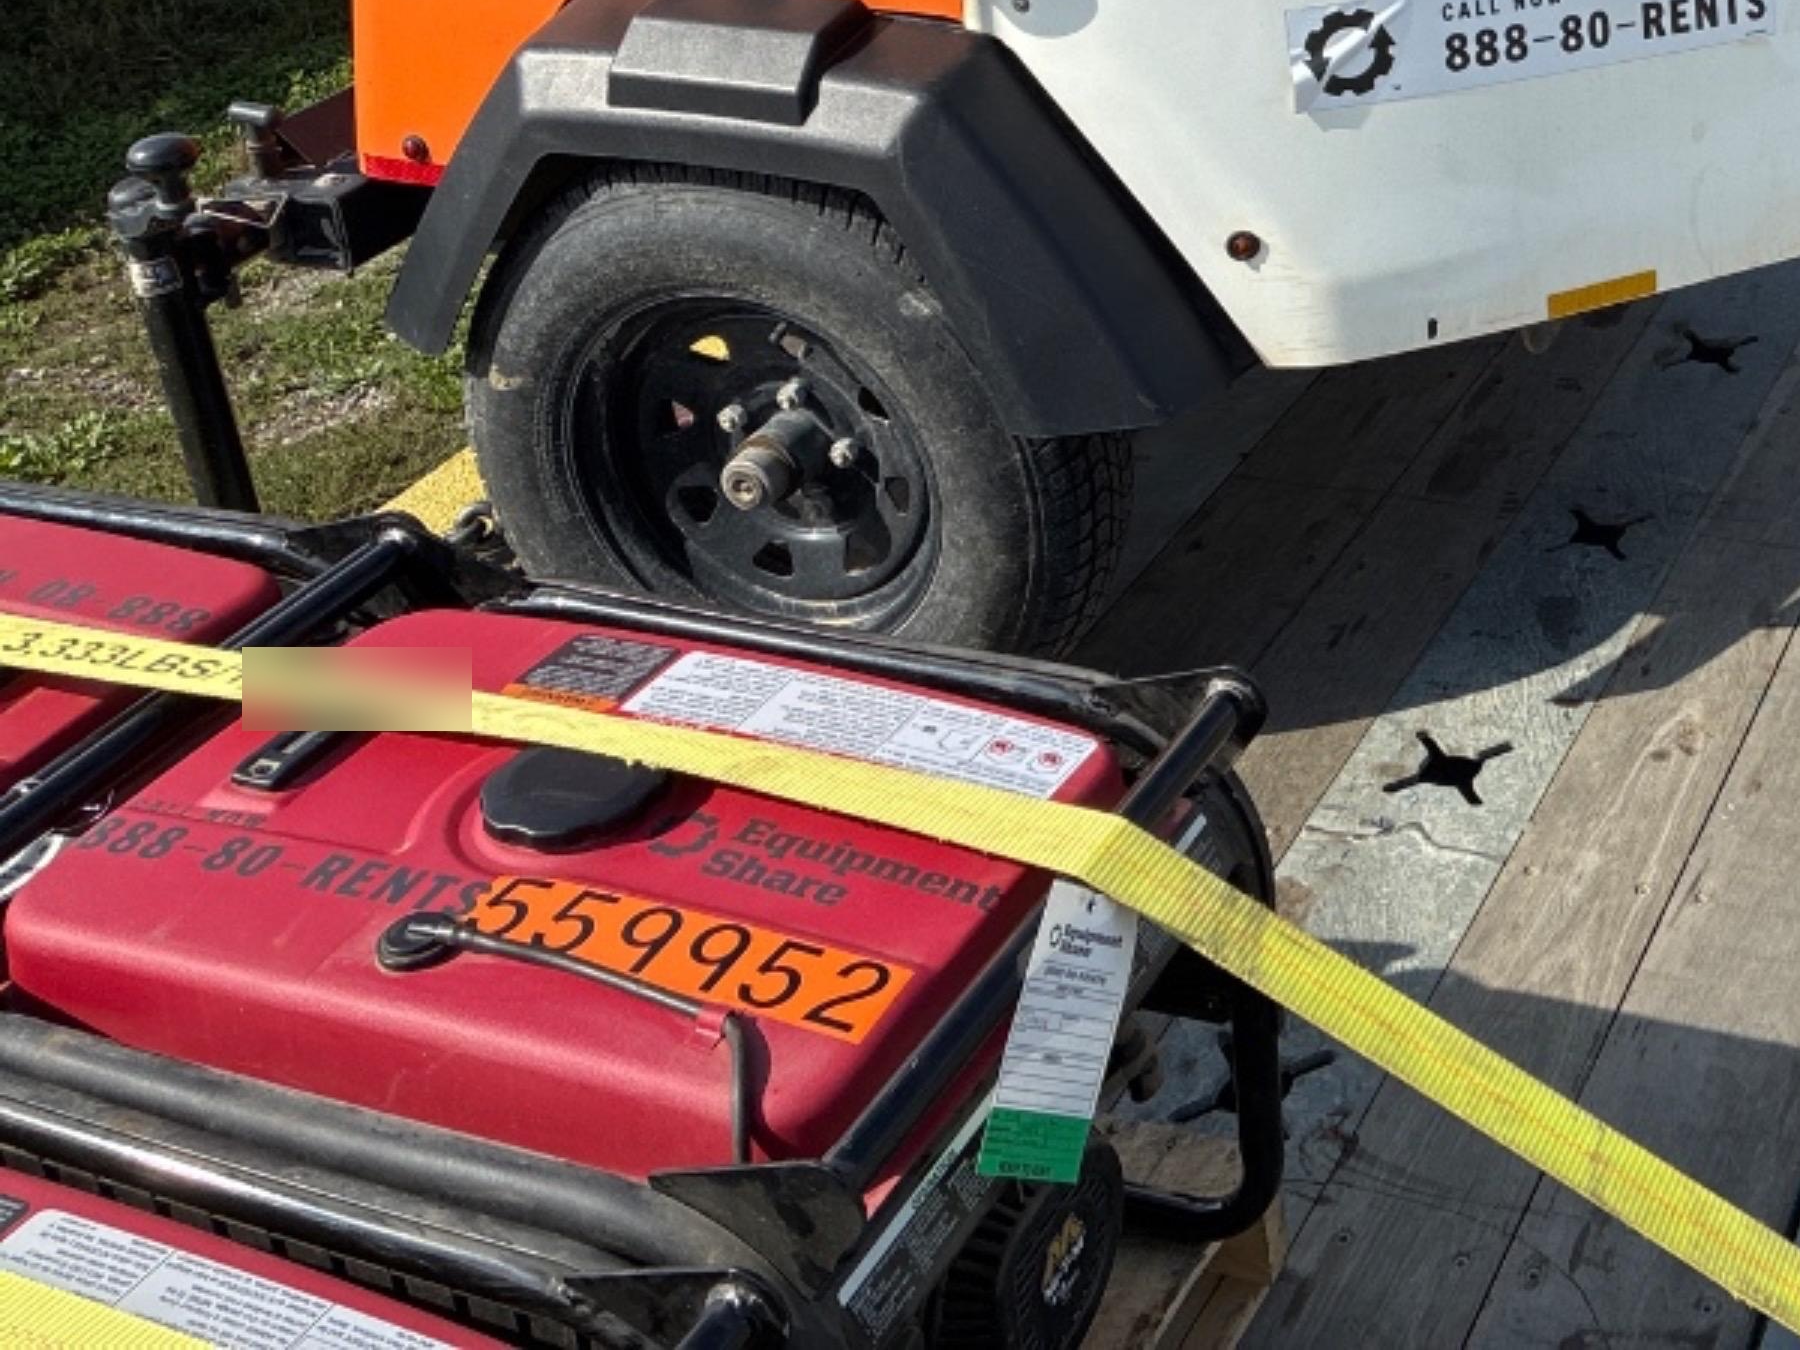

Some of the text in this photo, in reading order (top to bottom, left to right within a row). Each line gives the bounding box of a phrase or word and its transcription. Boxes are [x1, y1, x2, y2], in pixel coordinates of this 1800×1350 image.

[703, 847, 848, 907] Share
[733, 817, 1005, 911] Equipment
[467, 877, 892, 1034] 559952
